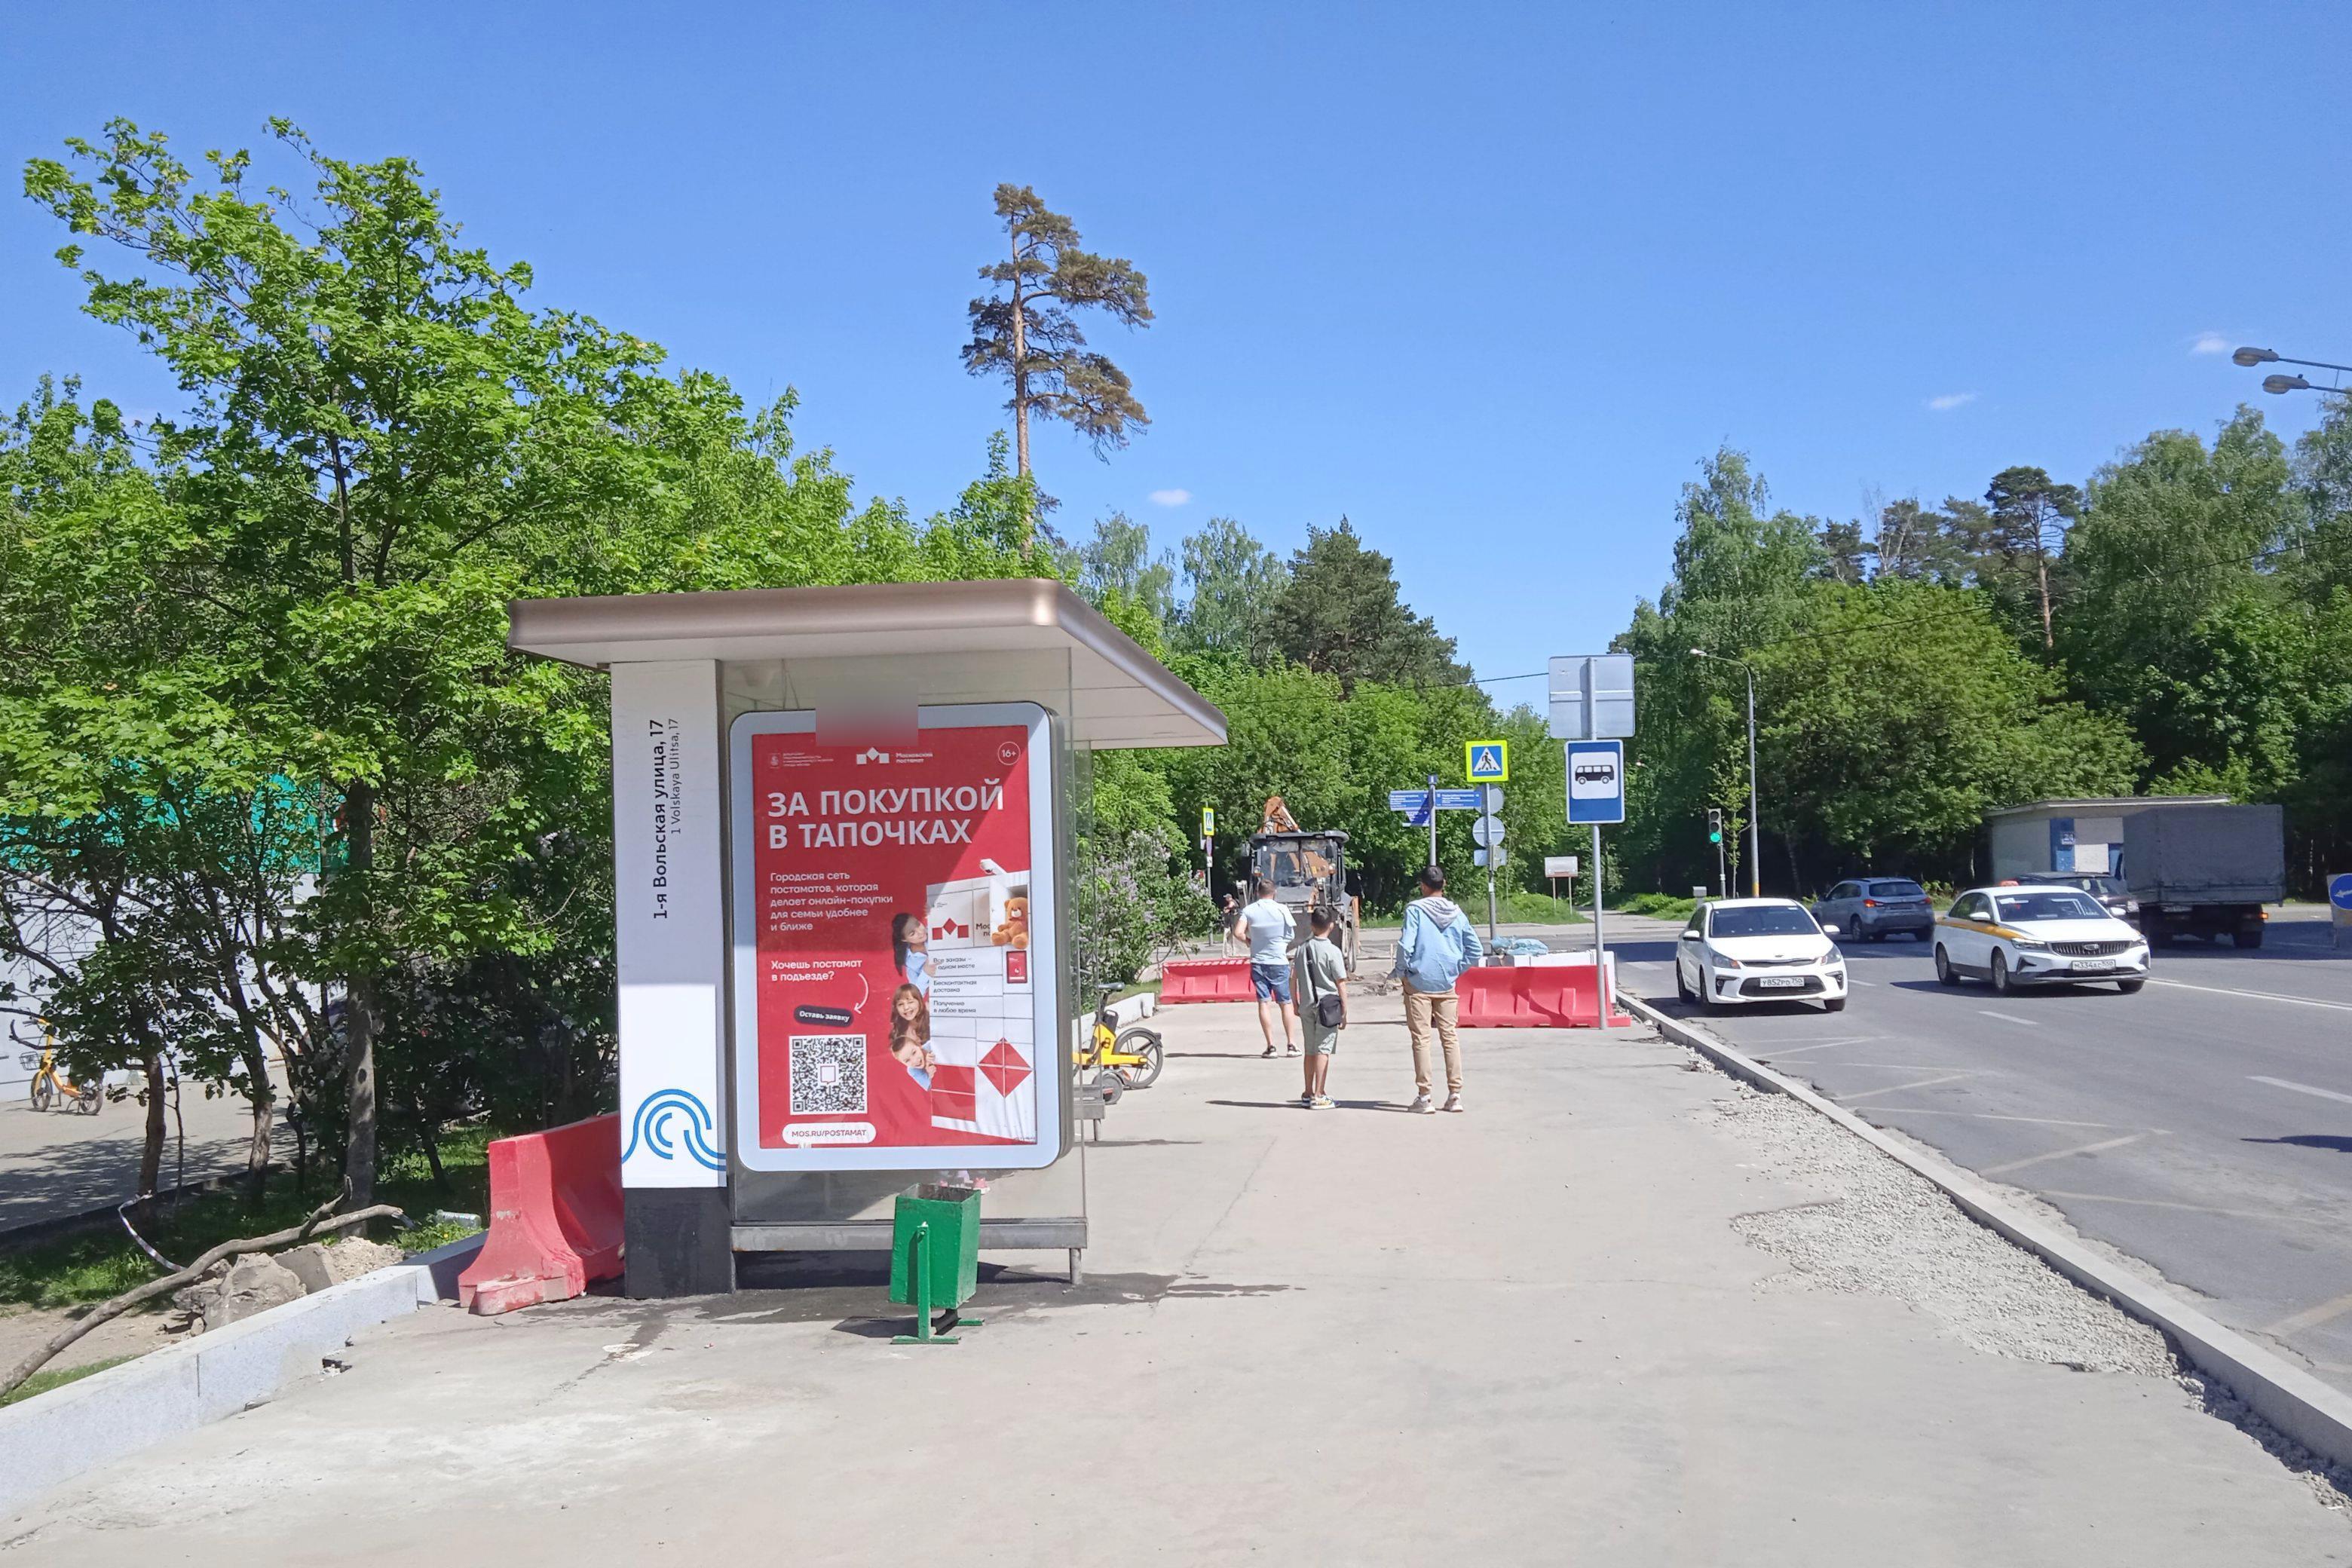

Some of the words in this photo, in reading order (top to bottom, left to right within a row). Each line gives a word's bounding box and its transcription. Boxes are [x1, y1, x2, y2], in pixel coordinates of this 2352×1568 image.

[650, 720, 663, 737] 17
[669, 718, 678, 730] 17
[669, 733, 680, 769] Ulitsa,
[1002, 749, 1016, 758] 16+
[654, 741, 668, 798] улица,
[670, 773, 681, 824] Volskaya
[767, 792, 810, 817] ЗА
[821, 778, 1003, 815] ПОКУПКОЙ
[769, 825, 788, 849] В
[799, 819, 972, 847] ТАПОЧКАХ
[654, 804, 666, 887] Вольская
[770, 872, 824, 882] Городская
[828, 871, 850, 880] сеть
[770, 886, 835, 894] постаматов,
[837, 884, 878, 893] которая
[654, 894, 667, 919] 1-я
[770, 899, 806, 908] делает
[808, 895, 893, 905] онлайн-покупки
[770, 911, 788, 920] для
[792, 910, 822, 918] семьи
[826, 908, 868, 920] удобнее
[780, 921, 813, 931] ближе
[771, 960, 810, 969] Хочешь
[813, 960, 862, 968] постамат
[781, 971, 835, 982] подъезде?
[799, 1010, 823, 1019] Оставь
[825, 1013, 850, 1023] заявку
[792, 1129, 867, 1138] MOS.RU/POSTAMAT
